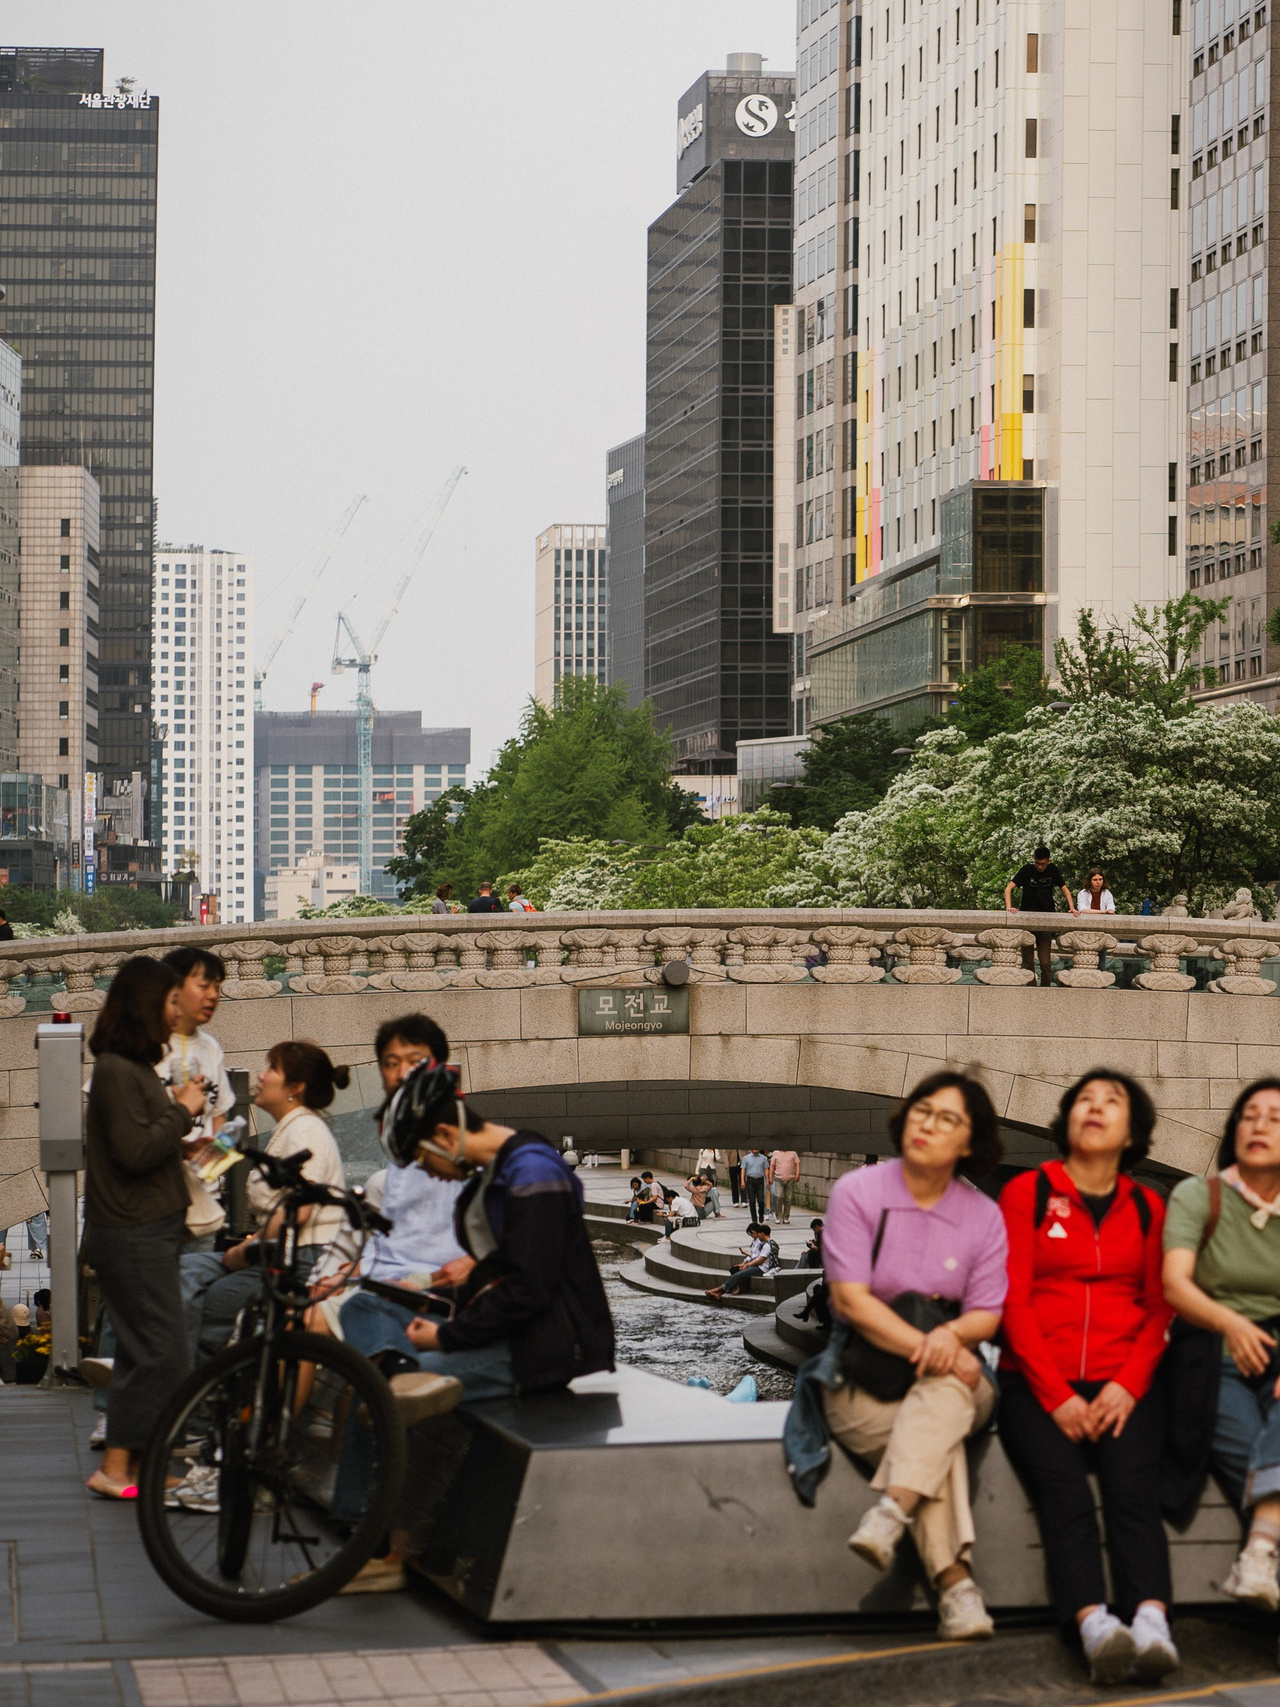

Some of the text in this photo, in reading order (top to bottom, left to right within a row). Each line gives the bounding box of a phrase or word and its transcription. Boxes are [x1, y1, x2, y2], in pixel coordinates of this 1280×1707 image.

[79, 93, 151, 109] 서울관광재단
[595, 993, 672, 1017] 모전교
[605, 1021, 663, 1031] Mojeongyo
